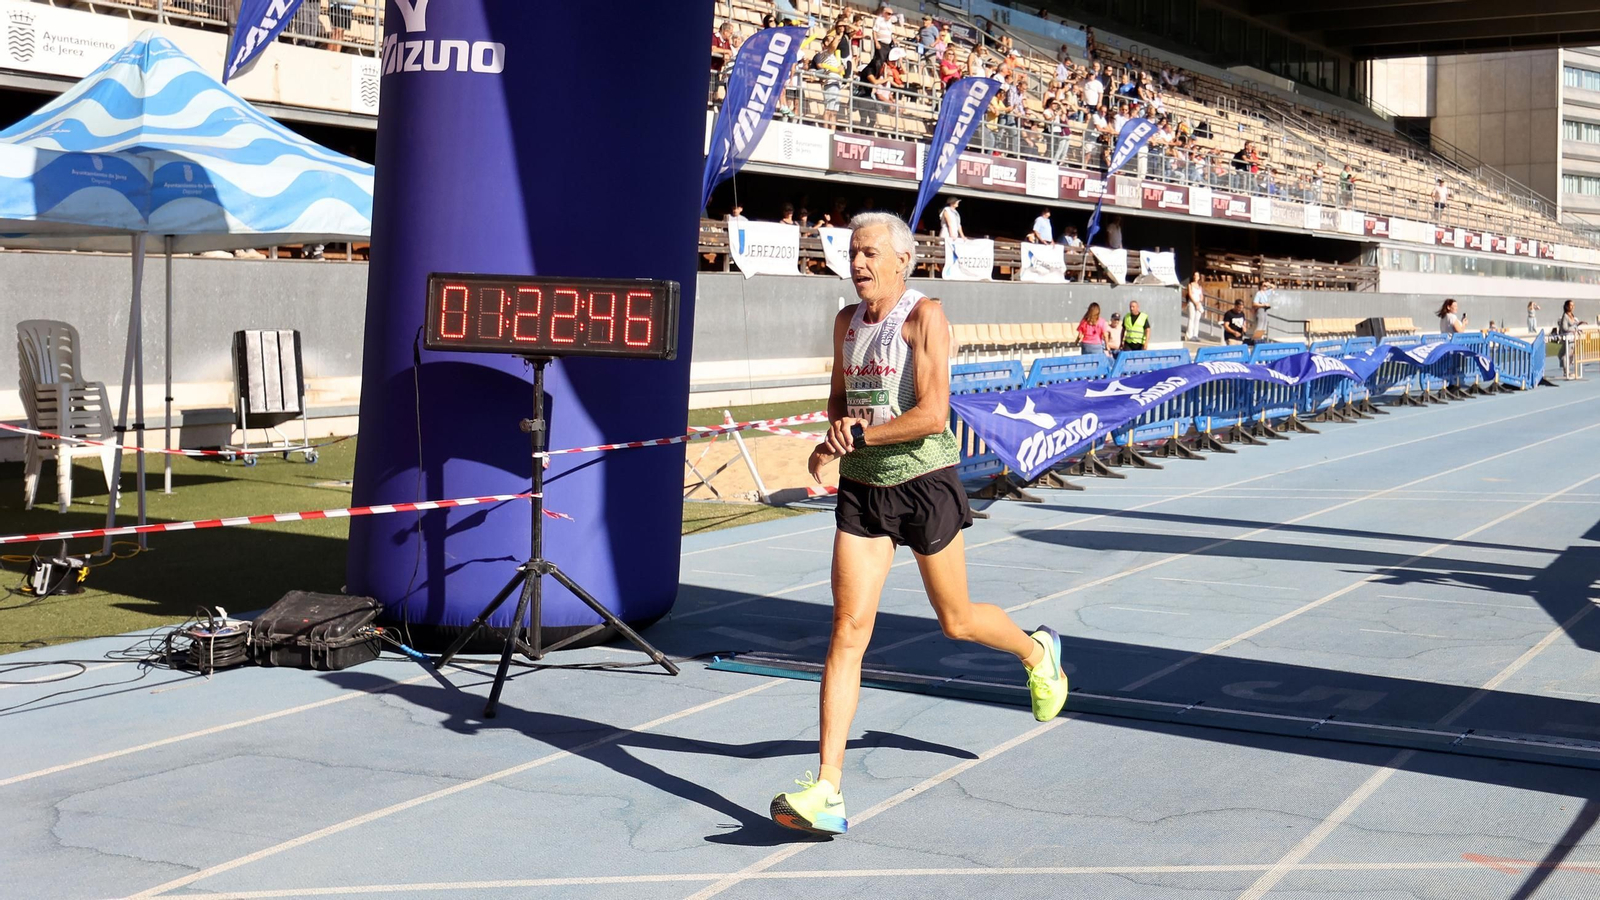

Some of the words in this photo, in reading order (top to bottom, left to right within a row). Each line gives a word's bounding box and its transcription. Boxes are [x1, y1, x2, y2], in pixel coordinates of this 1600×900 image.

[43, 31, 116, 50] Ayuntamiento
[43, 43, 55, 52] de
[59, 45, 84, 56] Jerez
[837, 141, 868, 160] PLAY
[860, 145, 905, 170] JEREZ
[960, 160, 989, 177] PLAY
[982, 164, 1017, 186] JEREZ
[1061, 176, 1084, 190] PLAY
[745, 244, 796, 260] JEREZ2031
[958, 256, 991, 269] EREZ2031
[440, 285, 653, 346] 01:22:46
[1016, 412, 1099, 473] MIZUNO
